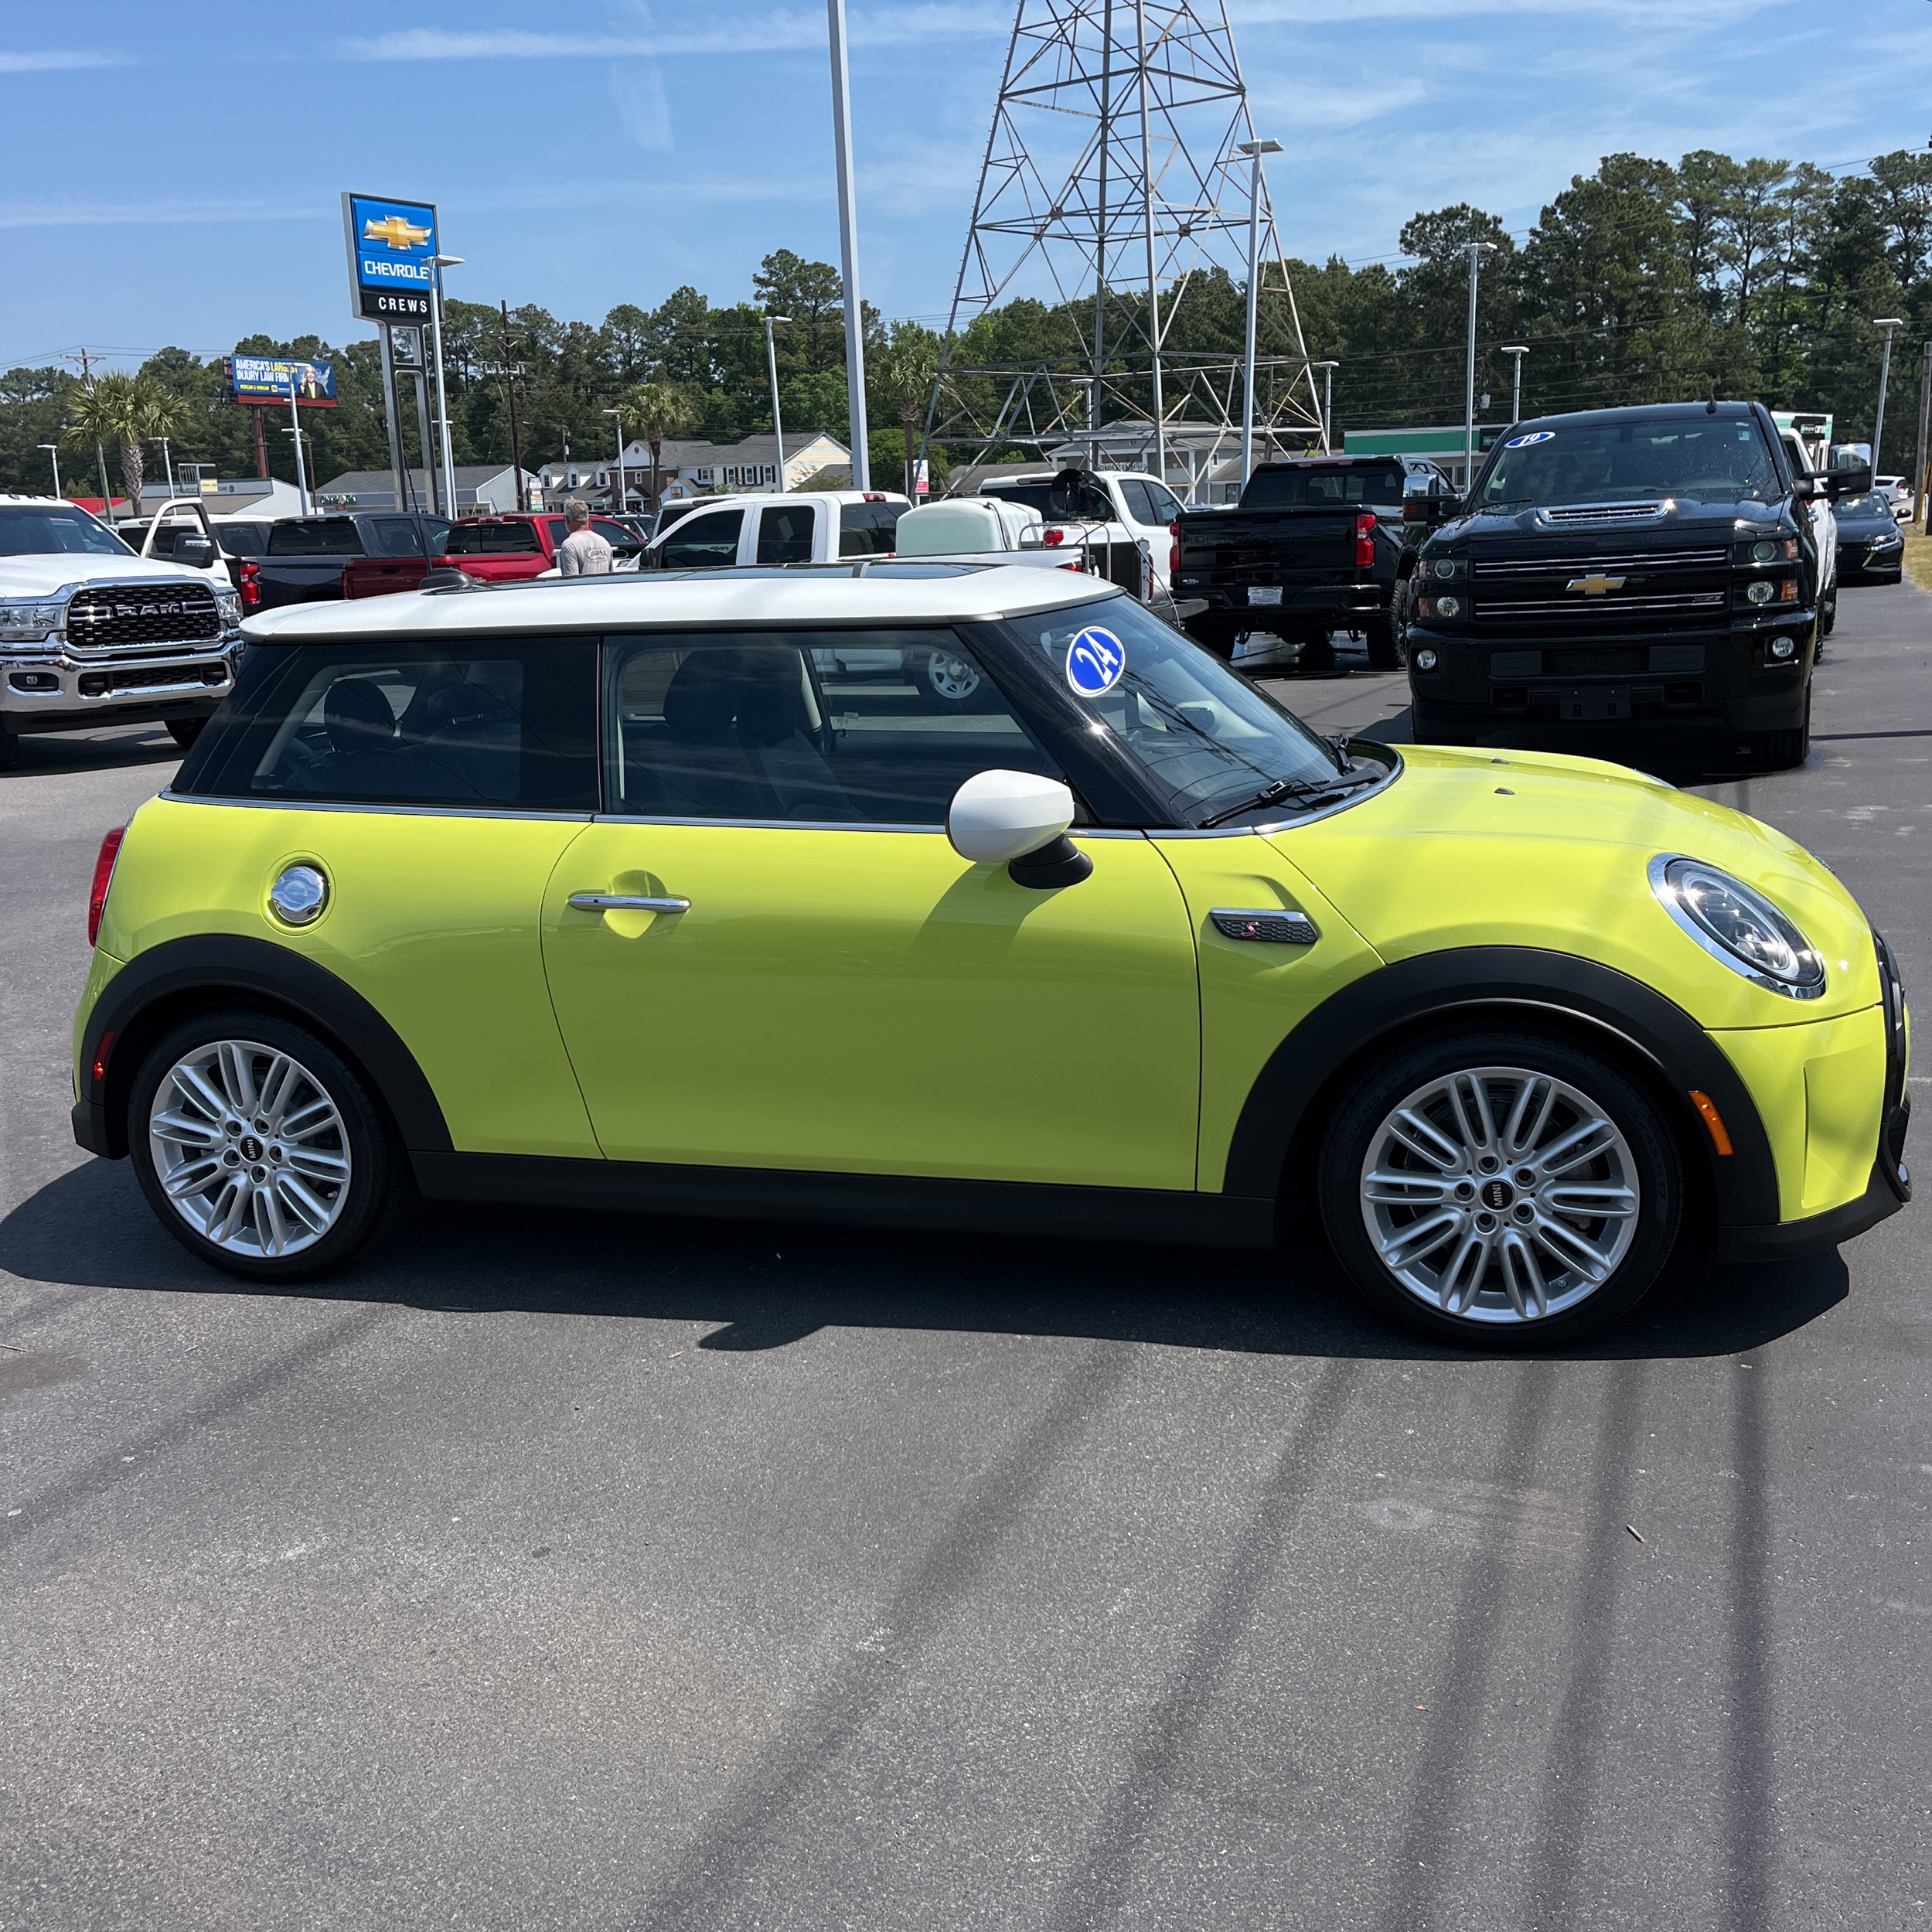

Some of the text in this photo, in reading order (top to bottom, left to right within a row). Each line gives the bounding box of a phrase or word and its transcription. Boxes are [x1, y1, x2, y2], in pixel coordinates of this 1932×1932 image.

[364, 261, 430, 279] CHEVROLE
[379, 297, 428, 313] CREWS
[236, 359, 298, 373] AMERICA'S LARGST
[237, 370, 259, 381] INJURY
[260, 372, 274, 382] LAW
[1517, 433, 1541, 446] 19
[116, 604, 179, 617] RAM
[1075, 632, 1119, 686] 24
[1242, 922, 1259, 937] S
[247, 1139, 257, 1159] MINI
[1492, 1184, 1503, 1206] MINI
